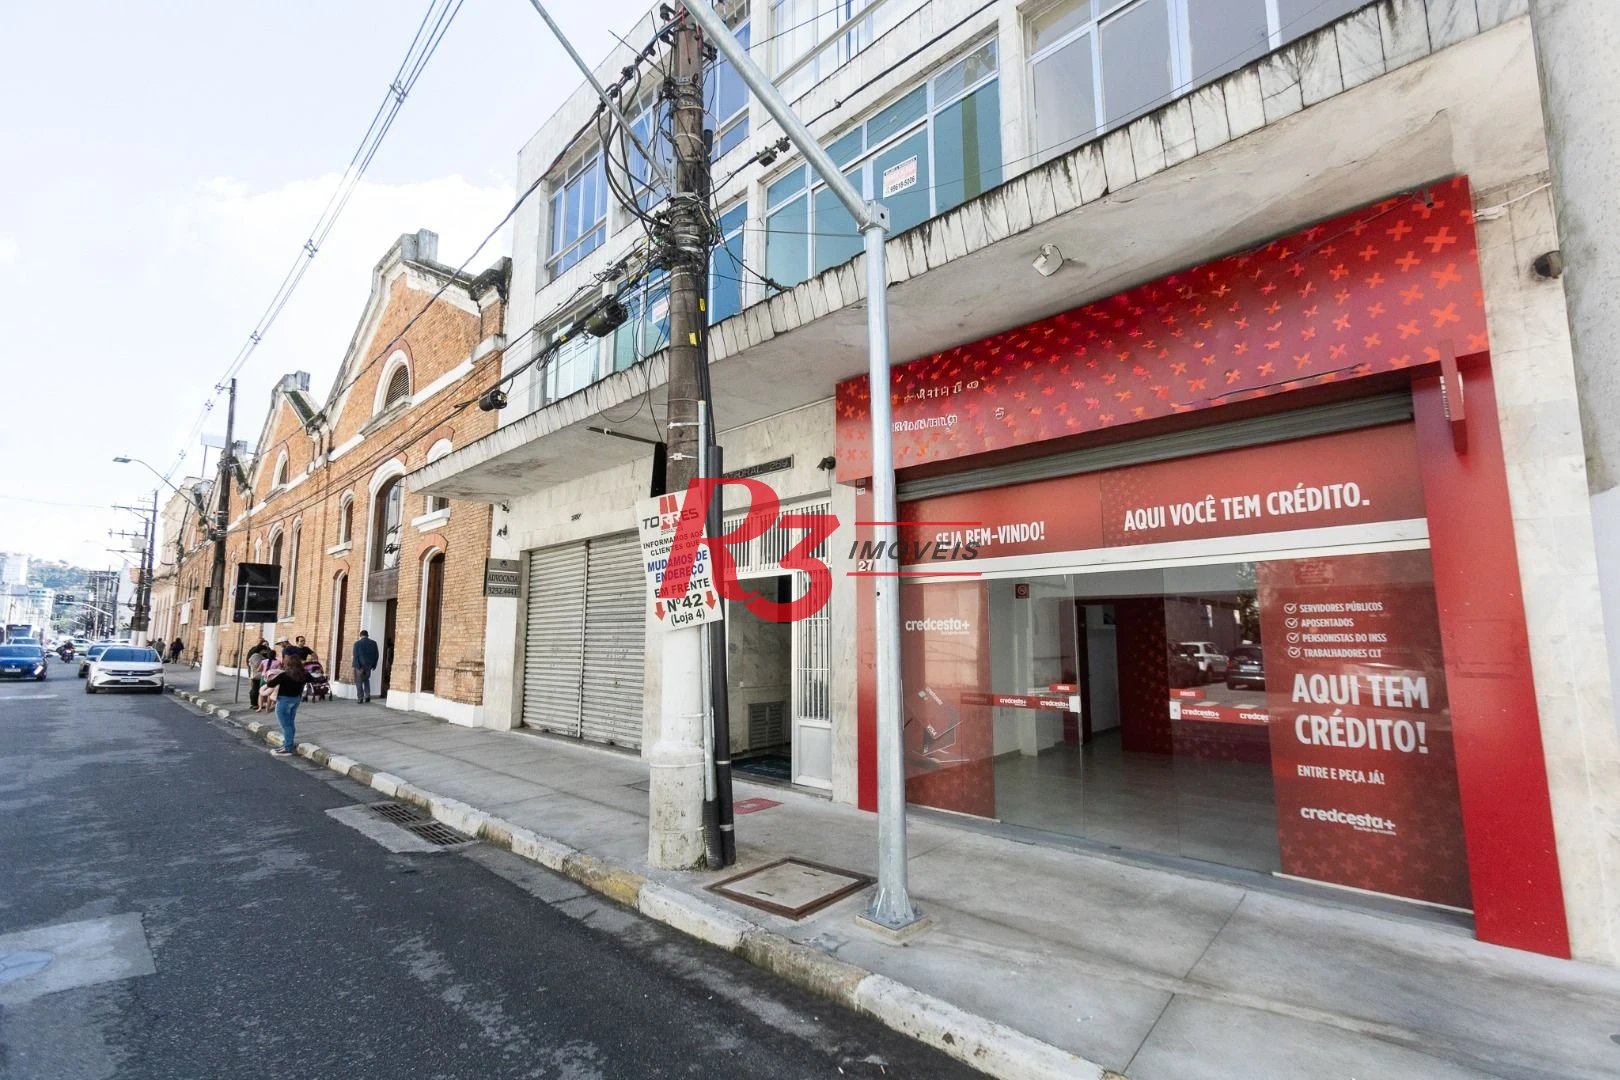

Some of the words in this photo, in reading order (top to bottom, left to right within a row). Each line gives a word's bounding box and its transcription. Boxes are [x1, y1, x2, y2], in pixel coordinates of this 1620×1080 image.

[1123, 505, 1166, 531] AQUI
[1169, 494, 1217, 526] VOCÊ
[1221, 494, 1262, 521] TEM
[1266, 482, 1371, 516] CRÉDITO.
[642, 507, 700, 530] TORRES
[643, 532, 687, 550] INFORMAMOS
[690, 529, 704, 541] AOS
[935, 530, 964, 550] SEJA
[965, 521, 1045, 548] BEM-VINDO!
[650, 544, 684, 557] CLIENTES
[685, 539, 700, 549] QUE
[647, 553, 693, 573] MUDAMOS
[696, 549, 708, 562] DE
[655, 563, 704, 583] ENDEREÇO
[654, 586, 669, 599] EM
[671, 577, 711, 595] FRENTE
[682, 593, 704, 609] 42
[1299, 602, 1345, 613] SERVIDORES
[1345, 601, 1384, 612] PÚBLICOS
[670, 612, 694, 627] (Loja
[695, 608, 706, 620] 4)
[1301, 617, 1355, 627] APOSENTADOS
[1302, 633, 1354, 643] PENSIONISTAS
[1356, 634, 1367, 642] DO
[1369, 633, 1387, 643] INSS
[1304, 648, 1367, 658] TRABALHADORES
[1369, 648, 1382, 657] CLT
[1292, 673, 1361, 706] AQUI
[1366, 675, 1430, 709] TEM
[1295, 708, 1430, 754] CRÉDITO!
[1297, 764, 1329, 779] ENTRE
[1330, 767, 1338, 779] E
[1338, 769, 1366, 784] PEÇA
[1366, 769, 1386, 785] JÁ!
